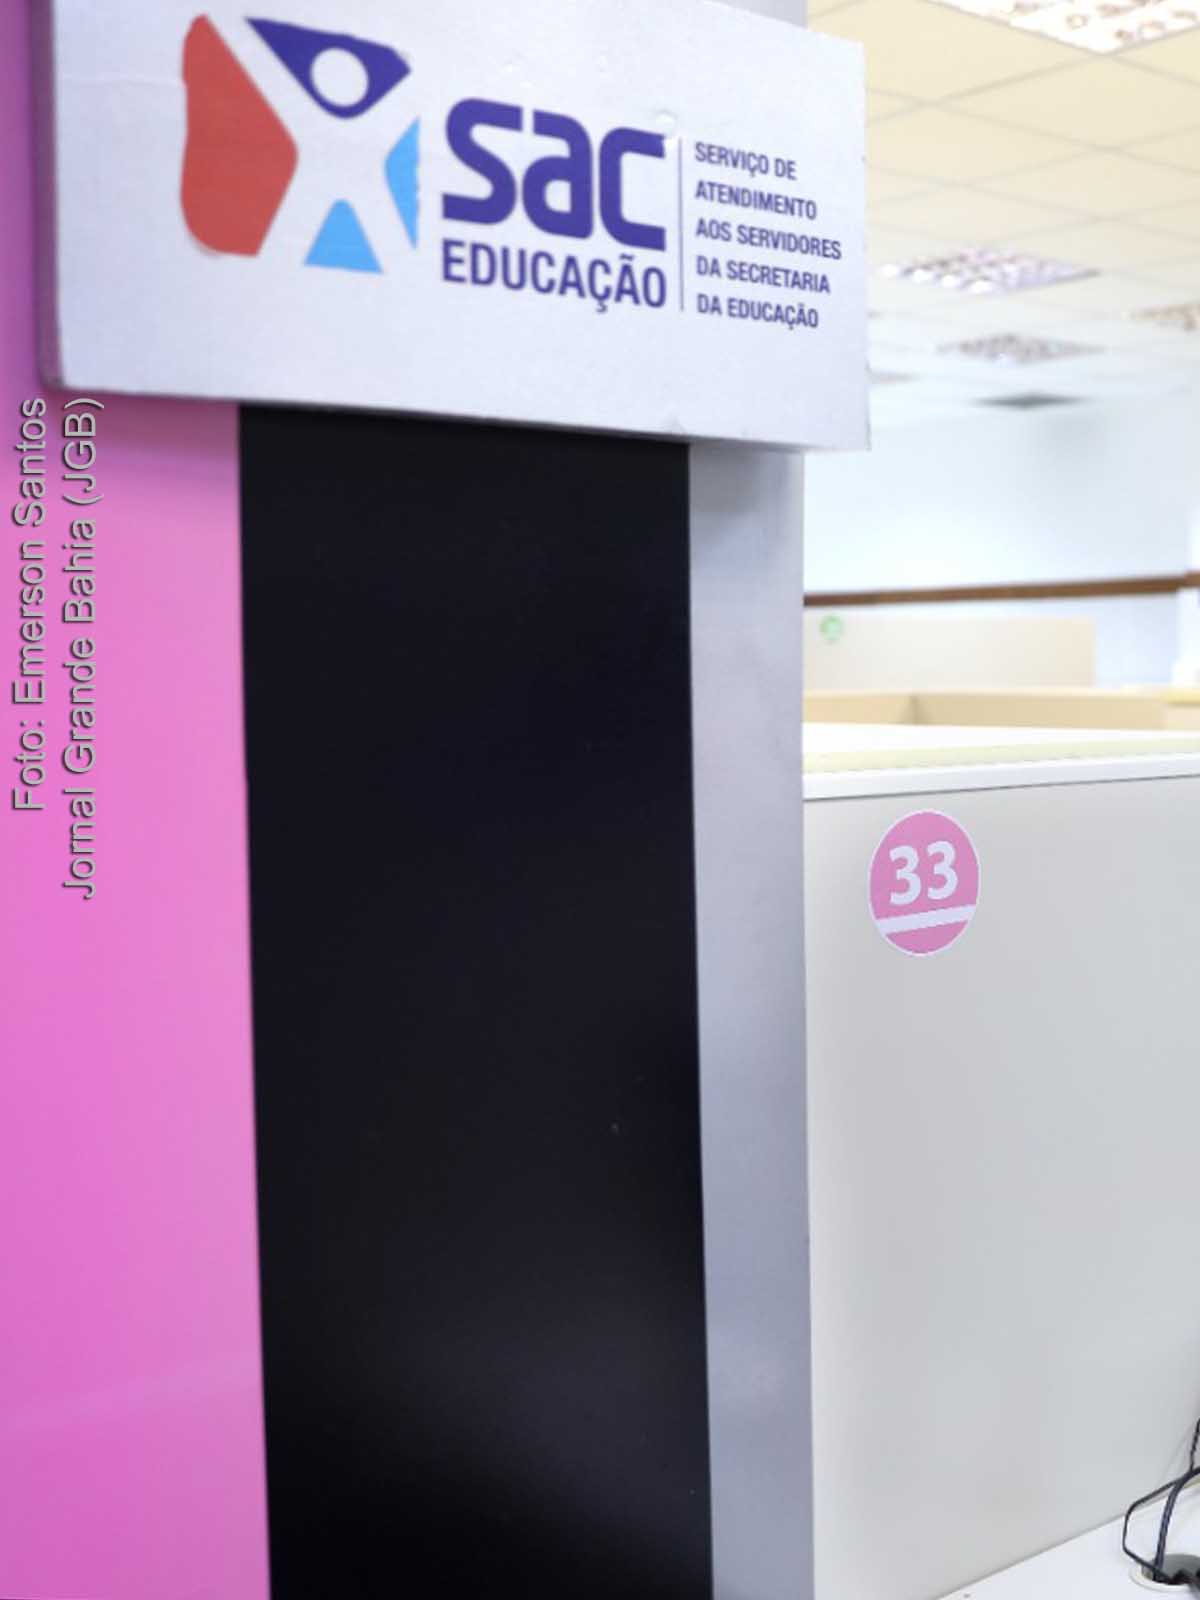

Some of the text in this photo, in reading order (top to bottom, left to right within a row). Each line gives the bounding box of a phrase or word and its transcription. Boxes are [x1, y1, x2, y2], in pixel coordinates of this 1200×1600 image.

[441, 97, 666, 252] sac
[695, 141, 797, 180] SERVIÇO DE
[695, 180, 817, 220] ATENDIMENTO
[696, 217, 842, 260] AOS SERVIDORES
[442, 238, 667, 313] EDUCAÇÃO
[697, 255, 831, 294] DA SECRETARIA
[697, 293, 819, 330] DA EDUCAÇÃO
[889, 841, 958, 905] 33
